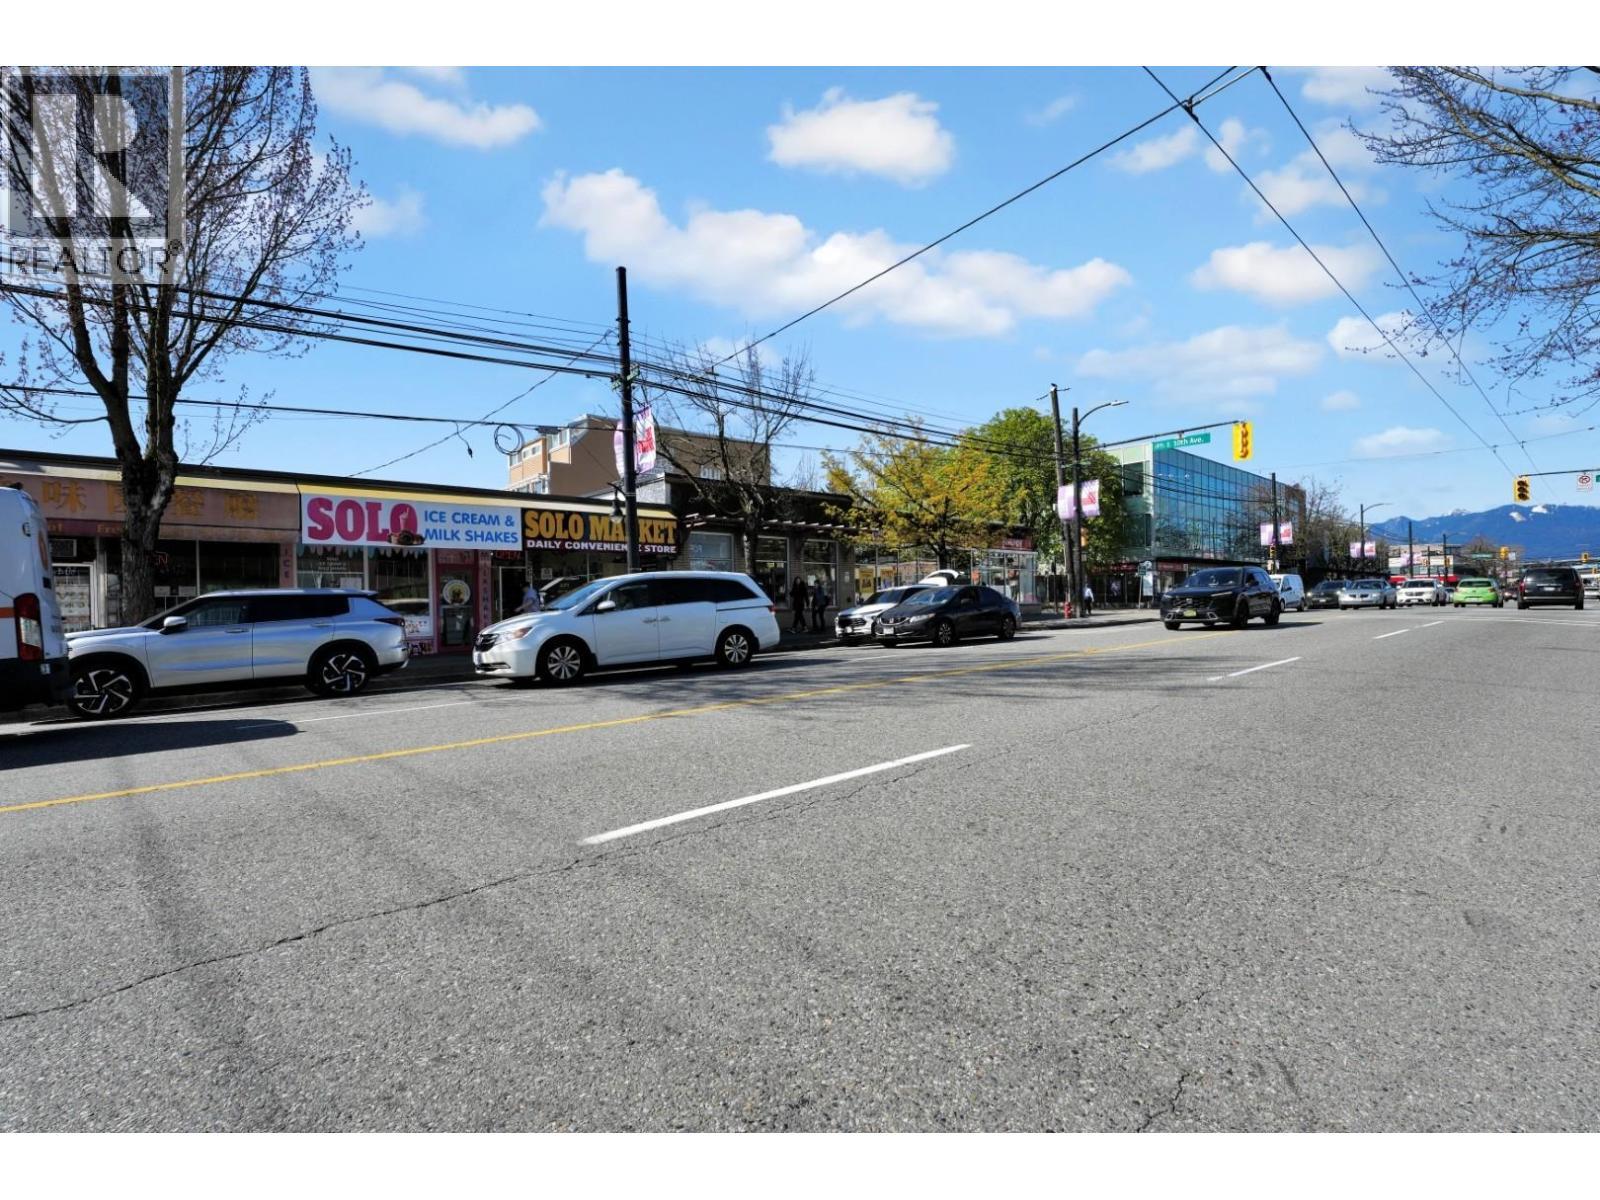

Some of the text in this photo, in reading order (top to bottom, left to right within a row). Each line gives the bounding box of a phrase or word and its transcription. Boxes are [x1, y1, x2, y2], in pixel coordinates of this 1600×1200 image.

[307, 498, 417, 541] SOLO
[424, 510, 514, 527] ICE CREAM &
[524, 510, 677, 544] SOLO MAKET
[425, 528, 519, 543] MILK SHAKES
[527, 539, 561, 549] DAILY
[645, 545, 677, 554] STORE
